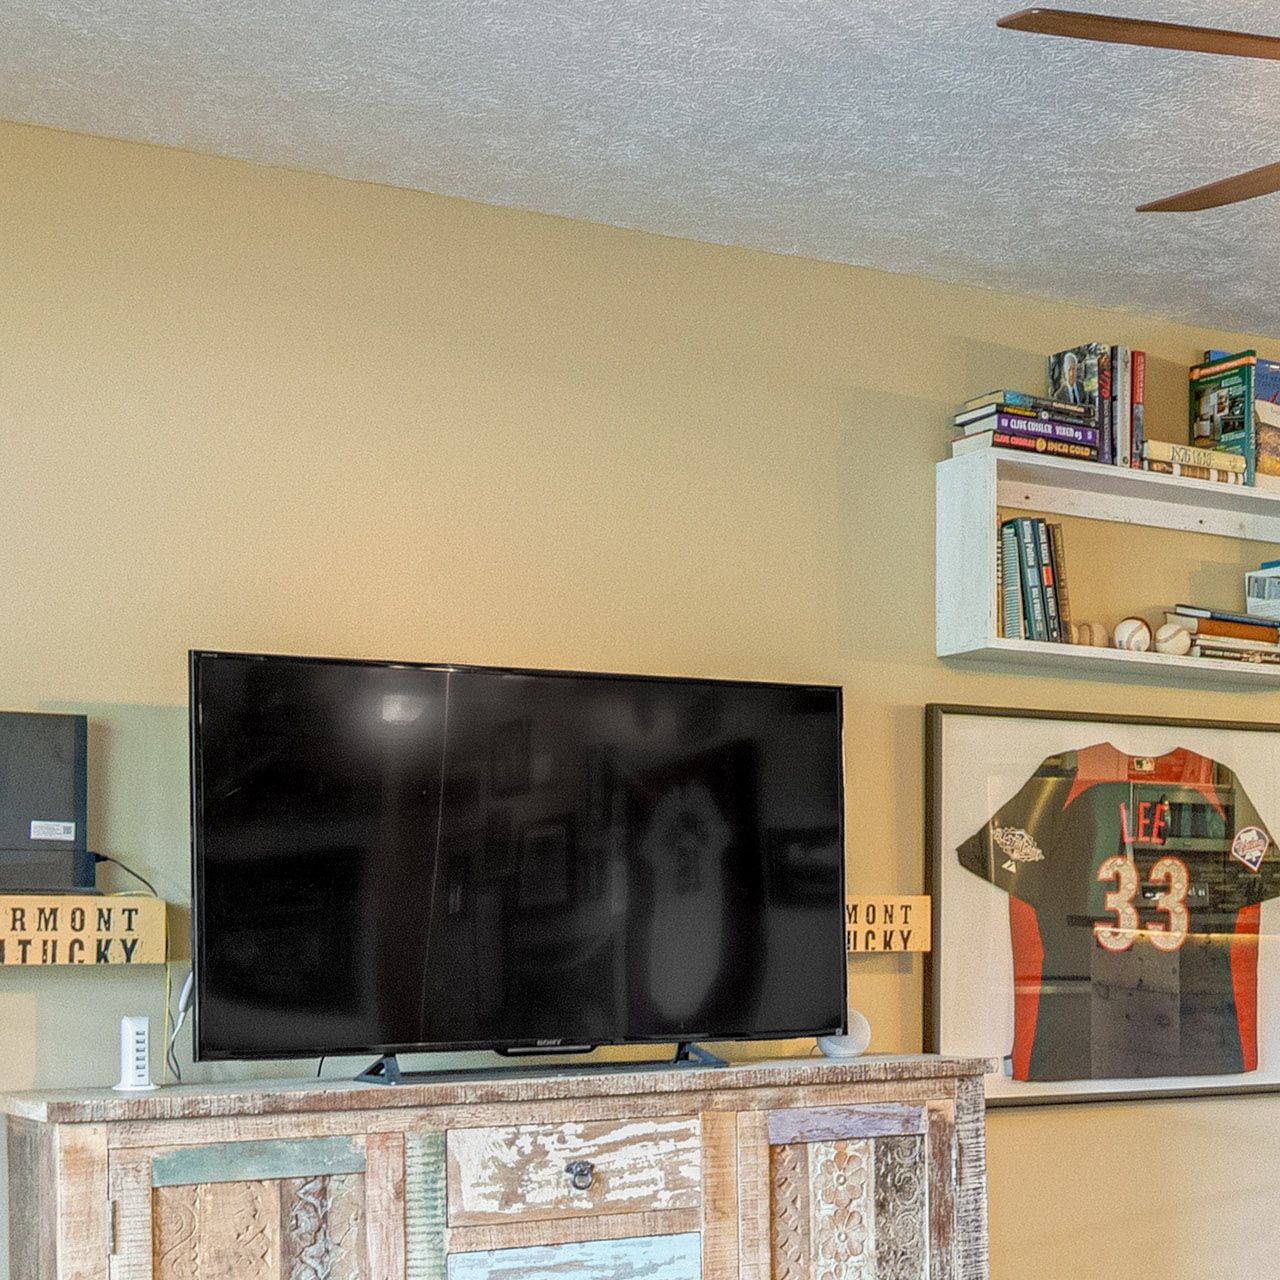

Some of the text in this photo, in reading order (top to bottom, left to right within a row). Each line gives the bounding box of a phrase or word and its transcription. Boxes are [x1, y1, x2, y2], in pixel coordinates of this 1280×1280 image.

[1010, 418, 1027, 431] CLIVE
[1027, 421, 1053, 434] CUSSLER
[1055, 425, 1074, 438] VIXEN
[1047, 441, 1069, 454] INCA
[1069, 445, 1090, 456] GOLD
[1026, 543, 1035, 566] Patton
[1120, 801, 1166, 845] LEE
[1094, 855, 1190, 952] 33
